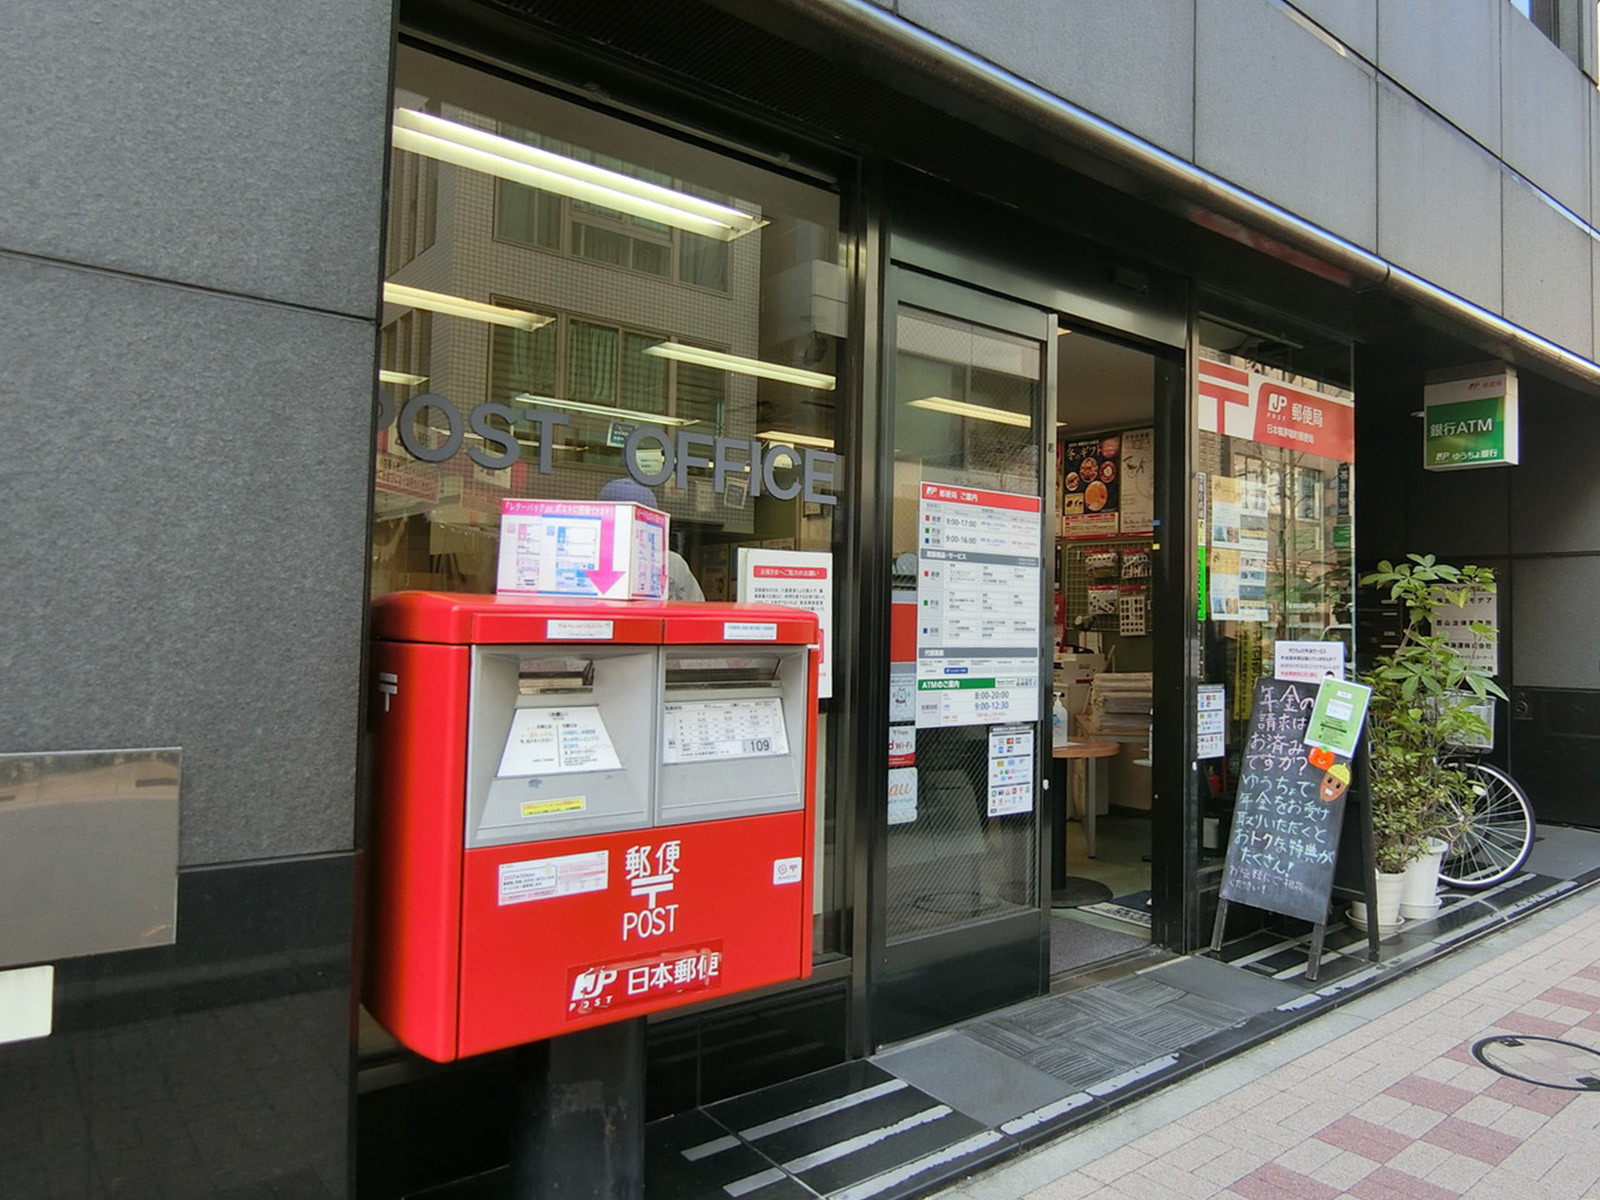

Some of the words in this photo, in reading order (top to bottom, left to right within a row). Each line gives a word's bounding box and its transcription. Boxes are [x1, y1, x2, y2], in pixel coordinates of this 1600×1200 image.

[1291, 402, 1323, 428] 郵便局
[1430, 418, 1493, 437] 銀行ATM
[625, 426, 838, 506] OFFICE
[1452, 448, 1498, 460] ゆうちょ銀行
[1260, 685, 1314, 712] 年金の
[1258, 713, 1307, 731] 請求は
[750, 740, 770, 752] 109
[1250, 731, 1305, 755] お済み
[1241, 773, 1316, 797] ゆうちょで
[1240, 791, 1330, 822] 年金をお受け
[1237, 811, 1327, 844] 取りいただくと
[624, 840, 682, 880] 郵便
[1234, 829, 1336, 864] おトクな特典が
[623, 904, 680, 941] POST
[627, 952, 720, 995] 日本郵便
